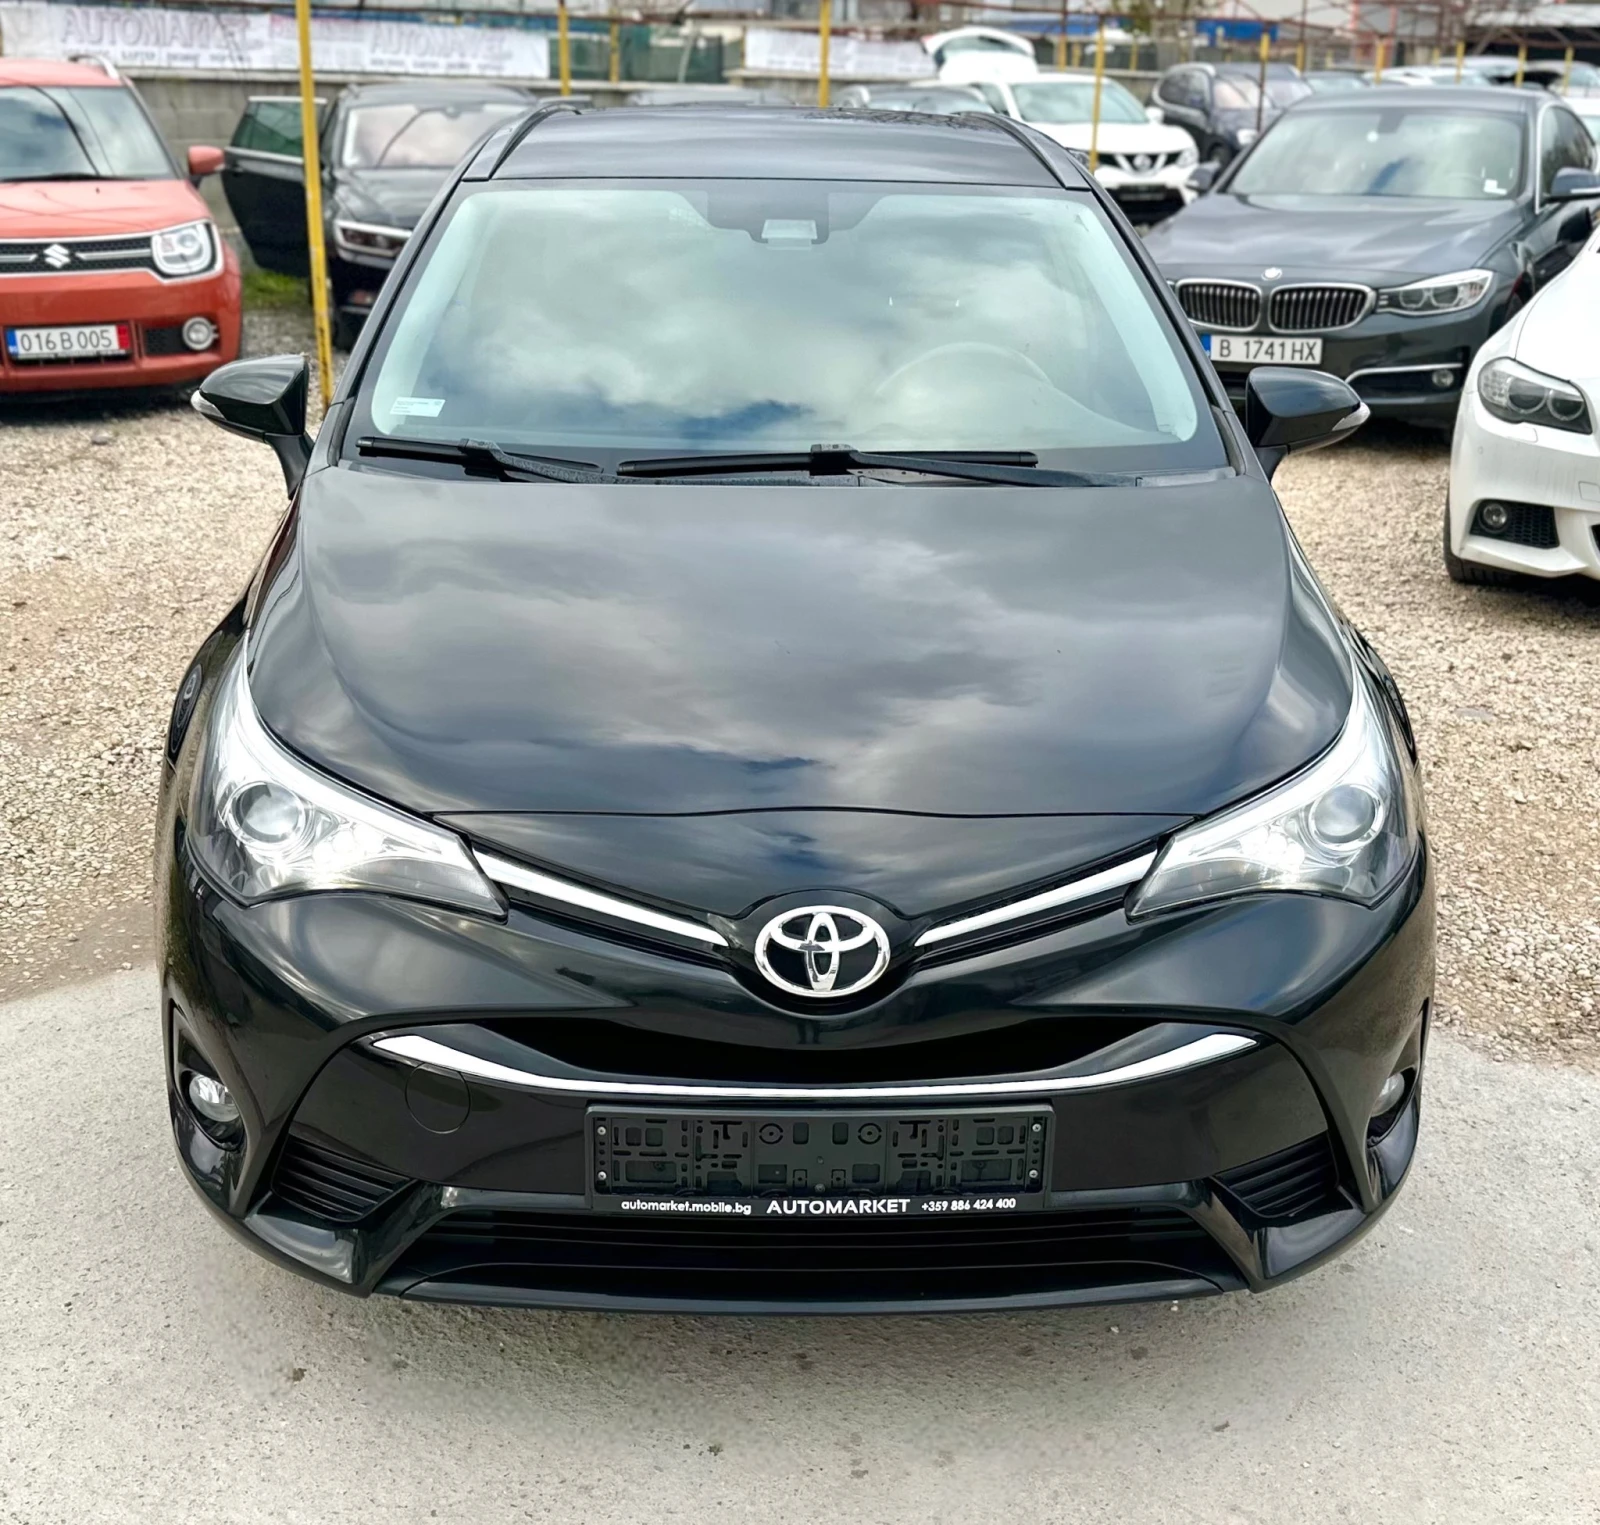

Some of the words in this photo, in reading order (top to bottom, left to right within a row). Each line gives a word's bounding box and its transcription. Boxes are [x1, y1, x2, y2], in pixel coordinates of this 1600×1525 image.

[61, 8, 249, 48] AUTOMART
[20, 332, 57, 352] 016
[60, 331, 73, 350] B
[77, 329, 112, 349] 005
[1219, 339, 1231, 358] B
[620, 1199, 752, 1216] automarket.mobile.bg
[766, 1199, 911, 1215] AUTOMARKET
[921, 1200, 949, 1212] +359
[950, 1200, 971, 1211] 886
[972, 1199, 994, 1210] 424
[995, 1198, 1017, 1209] 400
